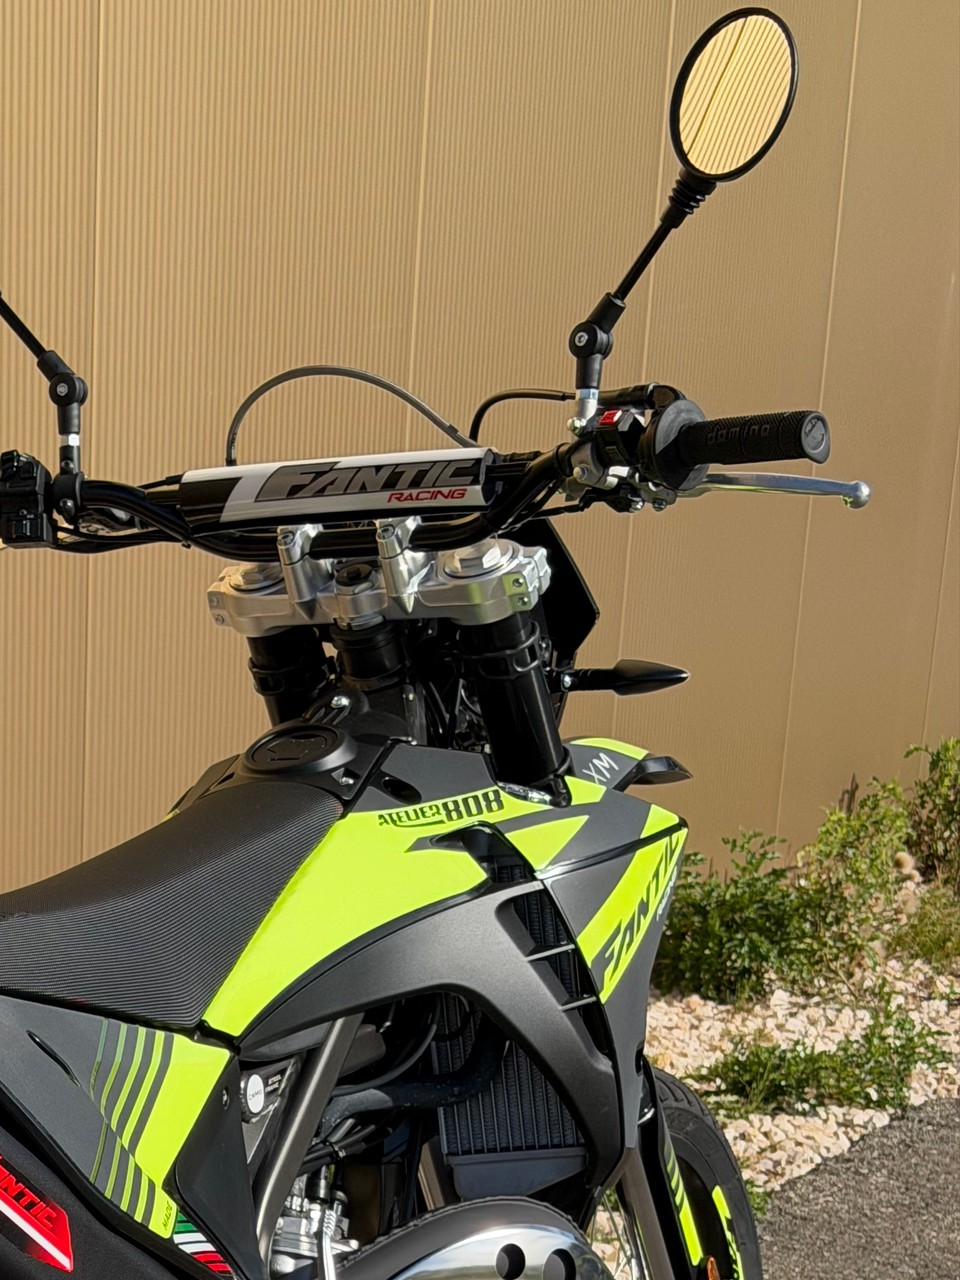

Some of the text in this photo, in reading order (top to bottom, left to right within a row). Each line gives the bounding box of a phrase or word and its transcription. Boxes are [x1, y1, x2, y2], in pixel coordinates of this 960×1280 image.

[254, 459, 478, 502] FANTIC
[387, 488, 468, 503] RACING
[583, 753, 618, 785] XM
[442, 789, 505, 821] 808
